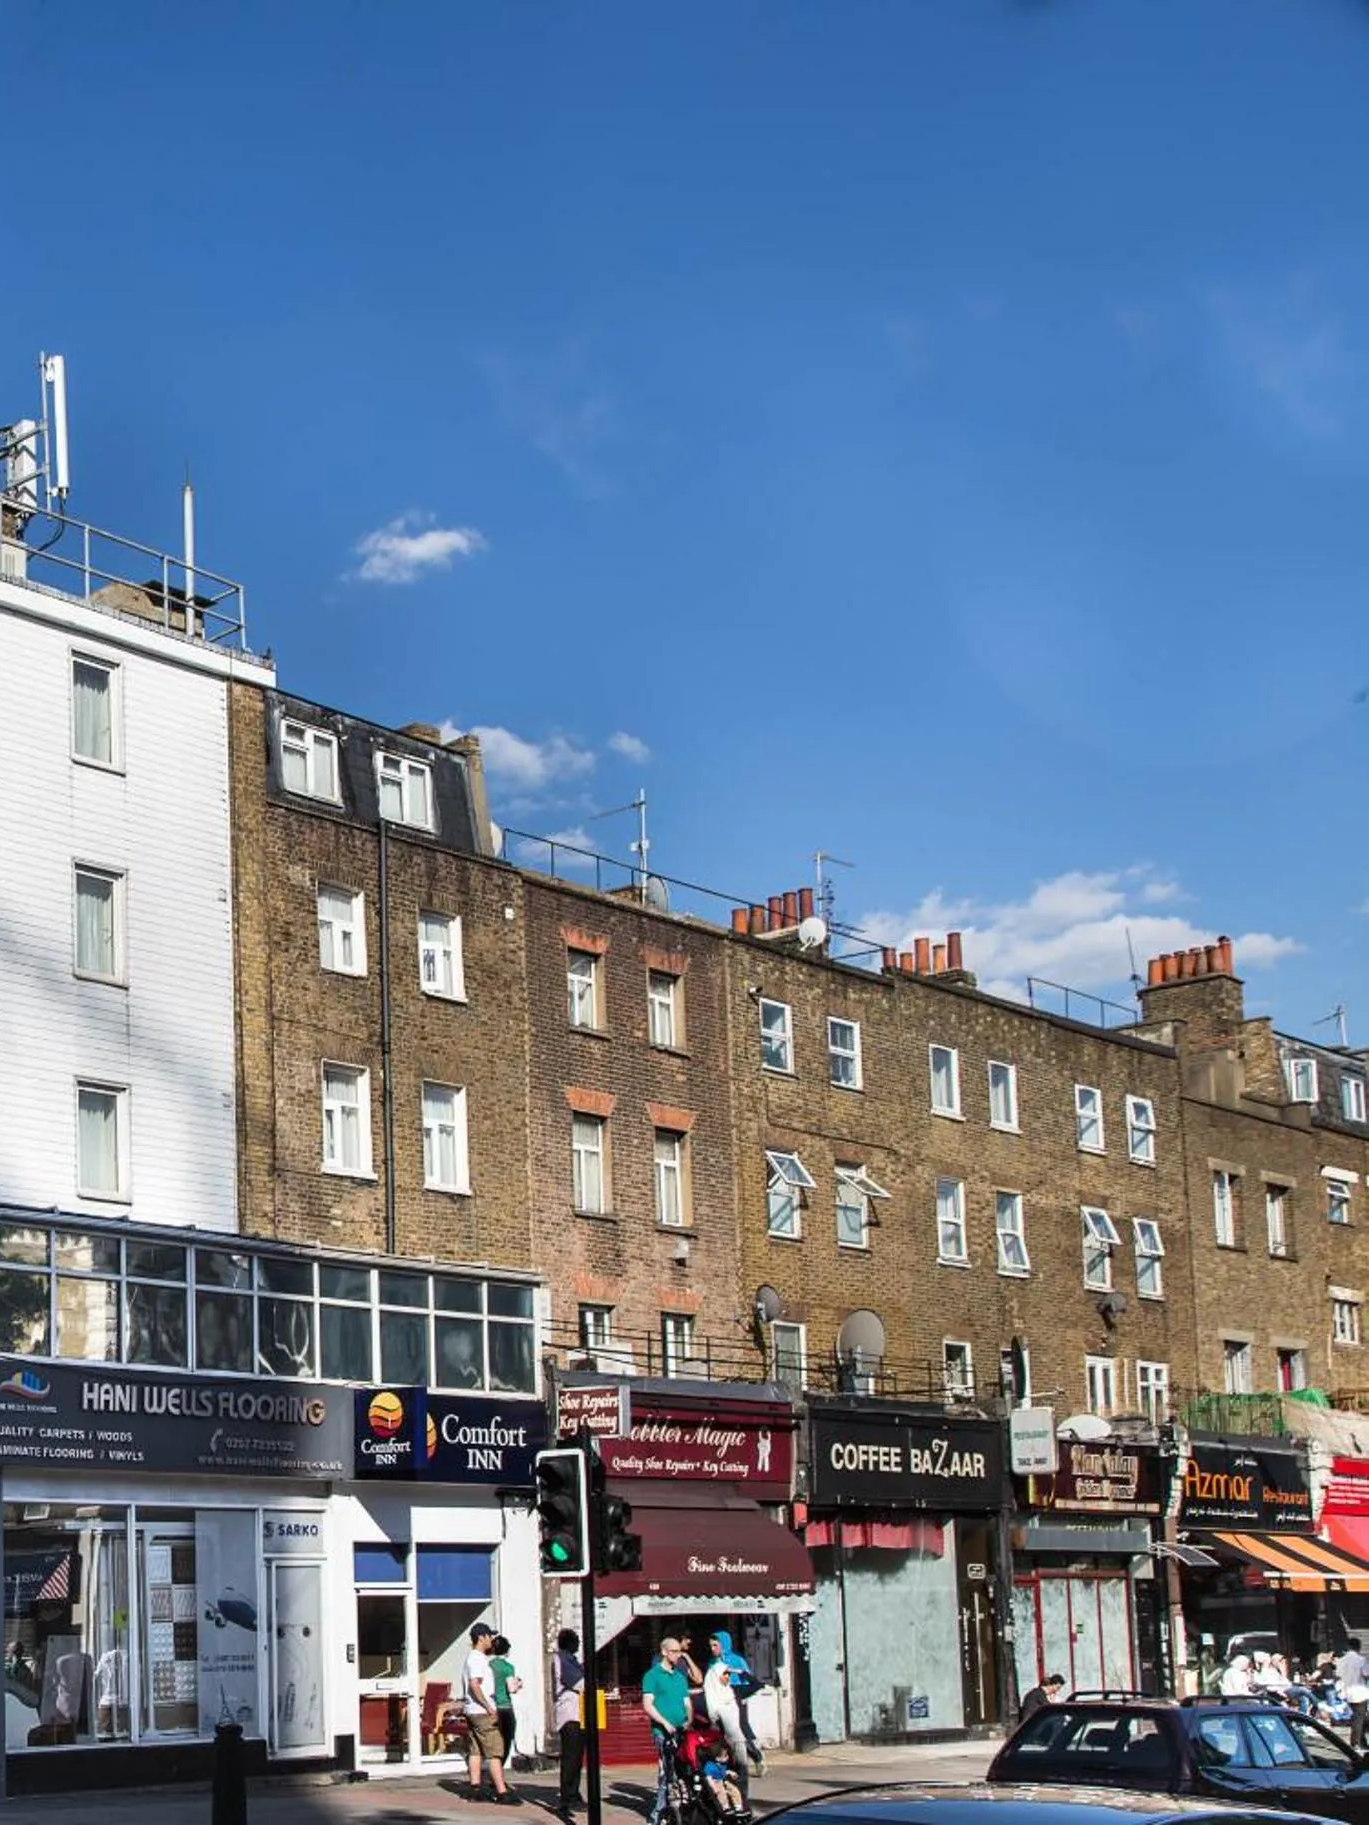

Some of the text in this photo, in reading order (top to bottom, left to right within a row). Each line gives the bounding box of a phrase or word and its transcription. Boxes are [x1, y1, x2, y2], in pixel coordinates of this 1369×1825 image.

[82, 1382, 326, 1425] HANI WELLS FLOORING
[558, 1393, 619, 1415] Shoe Repairs
[441, 1413, 527, 1447] Comfort
[559, 1411, 618, 1436] Key Cutting
[39, 1428, 85, 1440] CARPETS
[97, 1430, 132, 1442] WOODS
[361, 1437, 412, 1454] Comfort
[629, 1413, 747, 1458] obbler Magic
[43, 1446, 94, 1460] FLOORING
[109, 1449, 145, 1462] VINYLS
[375, 1453, 397, 1465] INN
[467, 1449, 504, 1470] INN
[831, 1438, 986, 1478] COFFEE BAZAAR
[612, 1456, 749, 1477] Quality Shoe Repairs Key Cutting
[1184, 1459, 1255, 1502] Azmar
[278, 1523, 319, 1537] SARKO
[687, 1555, 770, 1575] Fine Footwear
